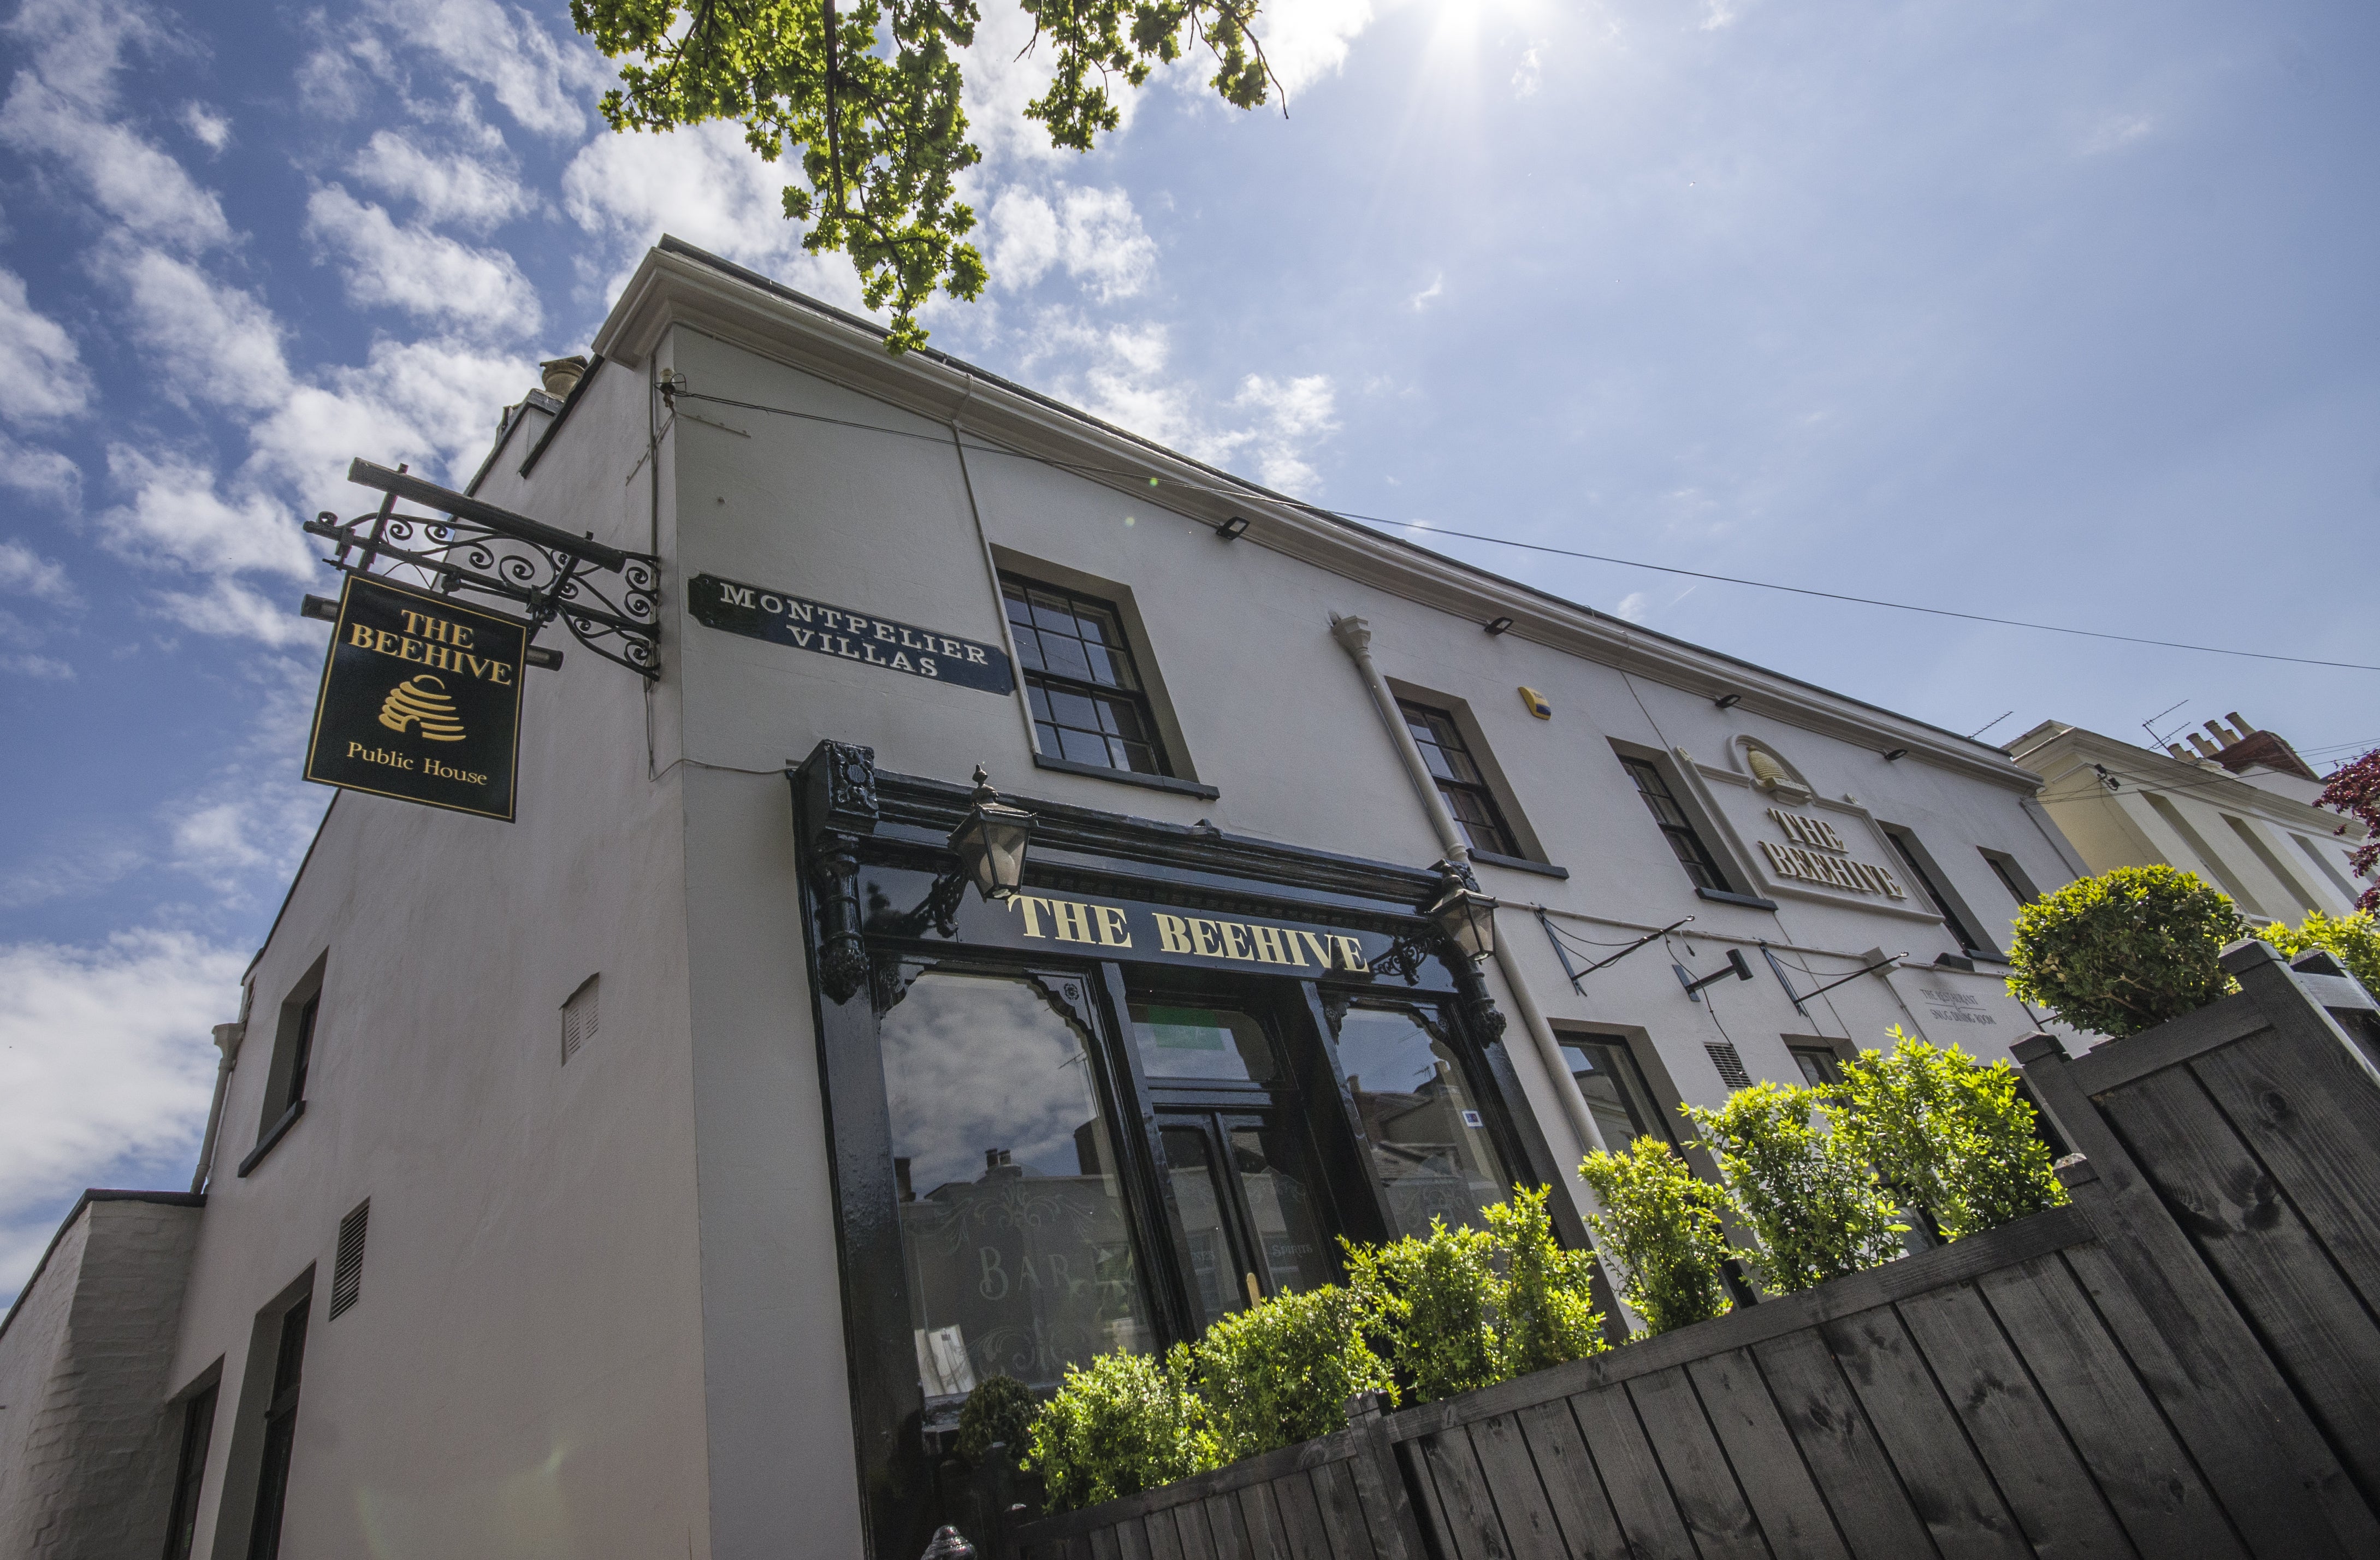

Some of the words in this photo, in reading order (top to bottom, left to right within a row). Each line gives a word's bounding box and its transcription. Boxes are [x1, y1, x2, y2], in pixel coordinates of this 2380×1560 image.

[401, 609, 474, 650] THE
[720, 583, 988, 665] MONTPELIER
[786, 624, 938, 676] VILLAS
[348, 622, 512, 686] BEEHIVE
[346, 741, 414, 770] Public
[423, 758, 488, 785] House
[1767, 808, 1849, 853] THE
[1757, 840, 1908, 900] BEEHIVE
[1007, 894, 1132, 948] THE
[1152, 912, 1370, 973] BEEHIVE
[979, 1245, 1084, 1301] BAR
